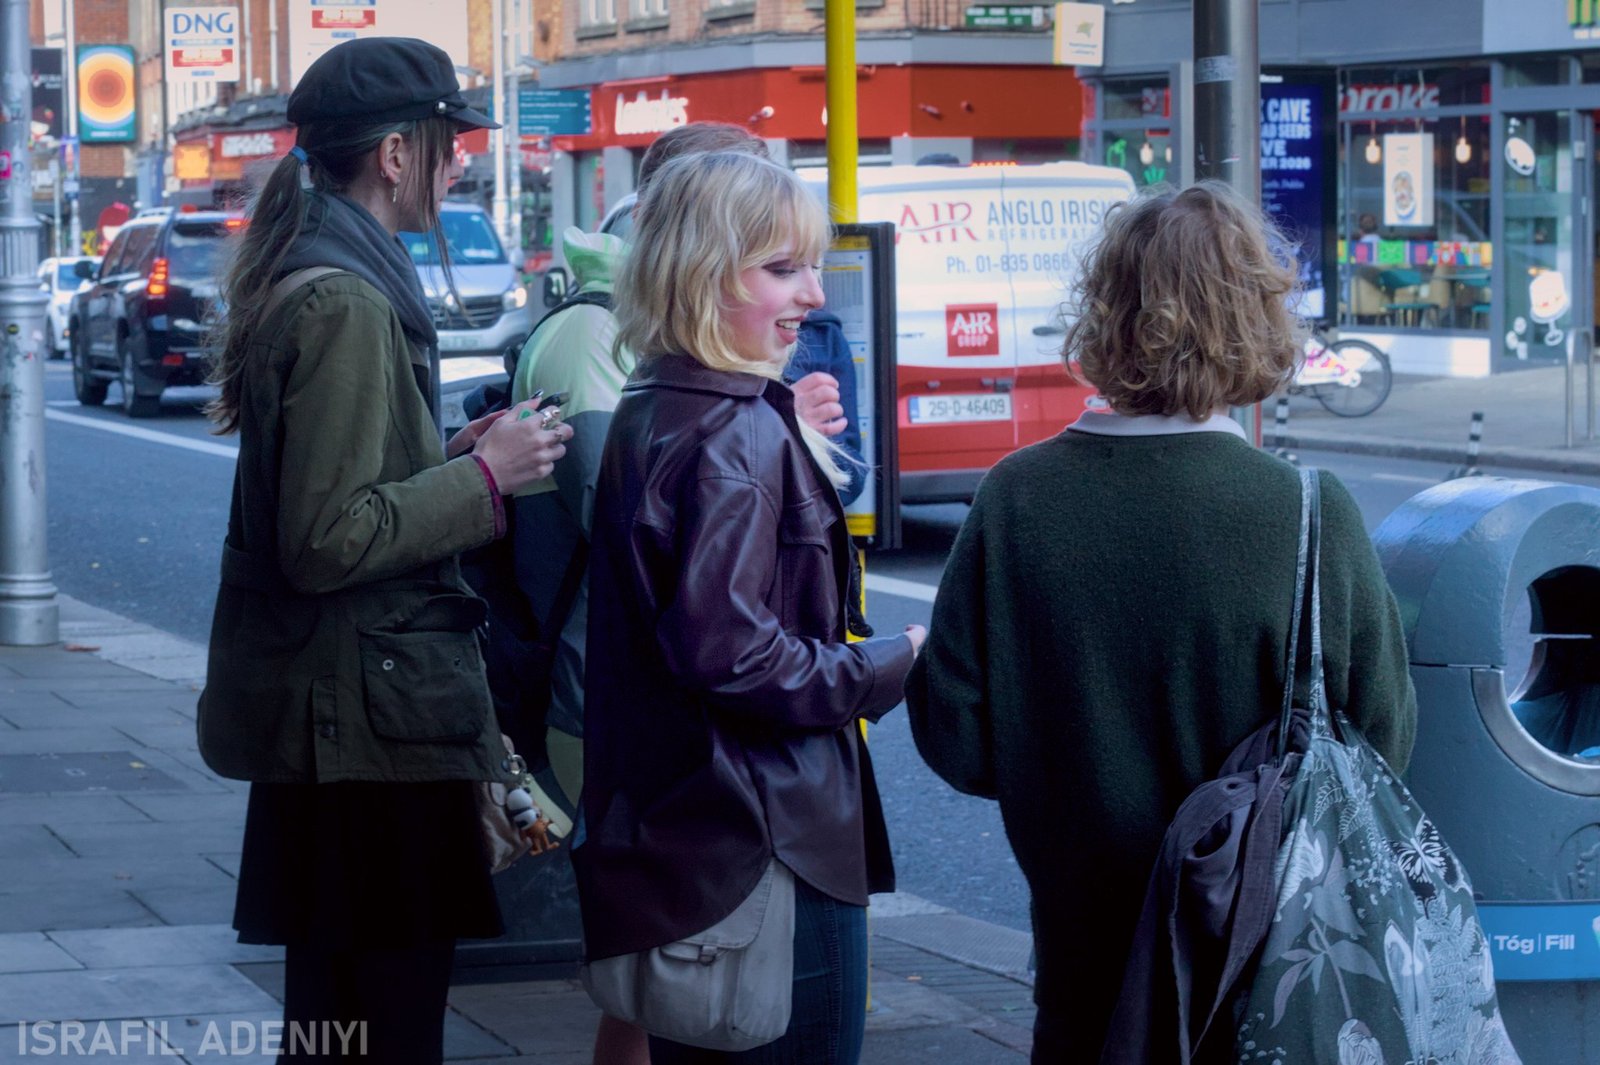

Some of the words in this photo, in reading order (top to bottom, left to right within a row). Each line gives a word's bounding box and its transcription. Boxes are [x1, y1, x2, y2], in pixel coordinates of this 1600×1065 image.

[172, 12, 234, 34] DNG
[1266, 98, 1311, 122] CAVE
[1260, 139, 1287, 156] VE
[894, 202, 979, 245] AIR
[987, 200, 1054, 226] ANGLO
[946, 256, 971, 273] Ph.
[975, 254, 1029, 273] 01-835
[951, 312, 994, 336] AIR
[1494, 934, 1534, 955] Tóg
[1545, 934, 1575, 950] Fill
